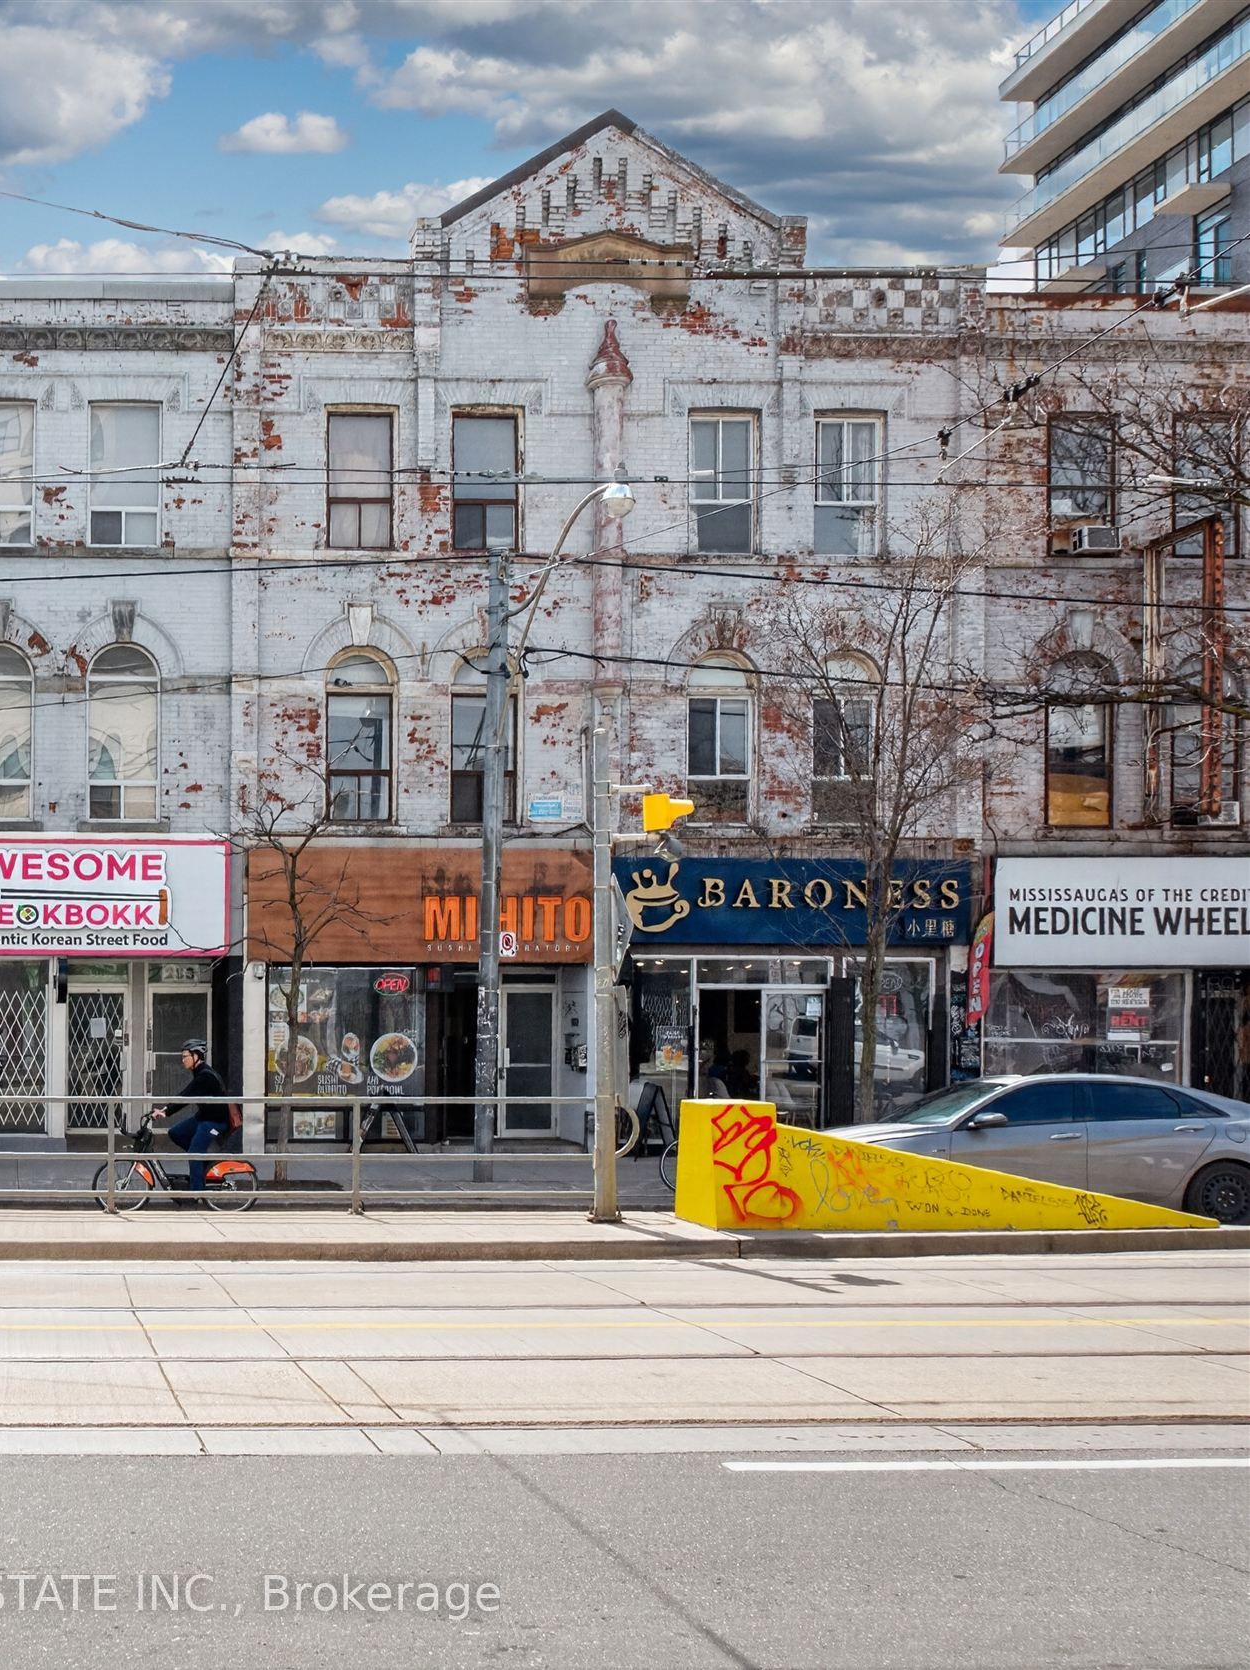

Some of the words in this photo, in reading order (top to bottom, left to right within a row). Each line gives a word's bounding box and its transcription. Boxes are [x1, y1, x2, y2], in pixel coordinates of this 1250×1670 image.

[697, 878, 960, 909] BARONESS
[1008, 888, 1129, 902] MISSISSAUGAS
[1136, 888, 1155, 902] OF
[1162, 888, 1194, 902] THE
[1008, 907, 1146, 936] MEDICINE
[1152, 906, 1250, 936] WHEEL
[31, 933, 82, 946] Korean
[86, 933, 129, 946] Street
[133, 933, 168, 946] Food
[427, 944, 473, 952] SUSHI
[969, 942, 985, 1013] OPEN
[376, 978, 408, 992] OPEN
